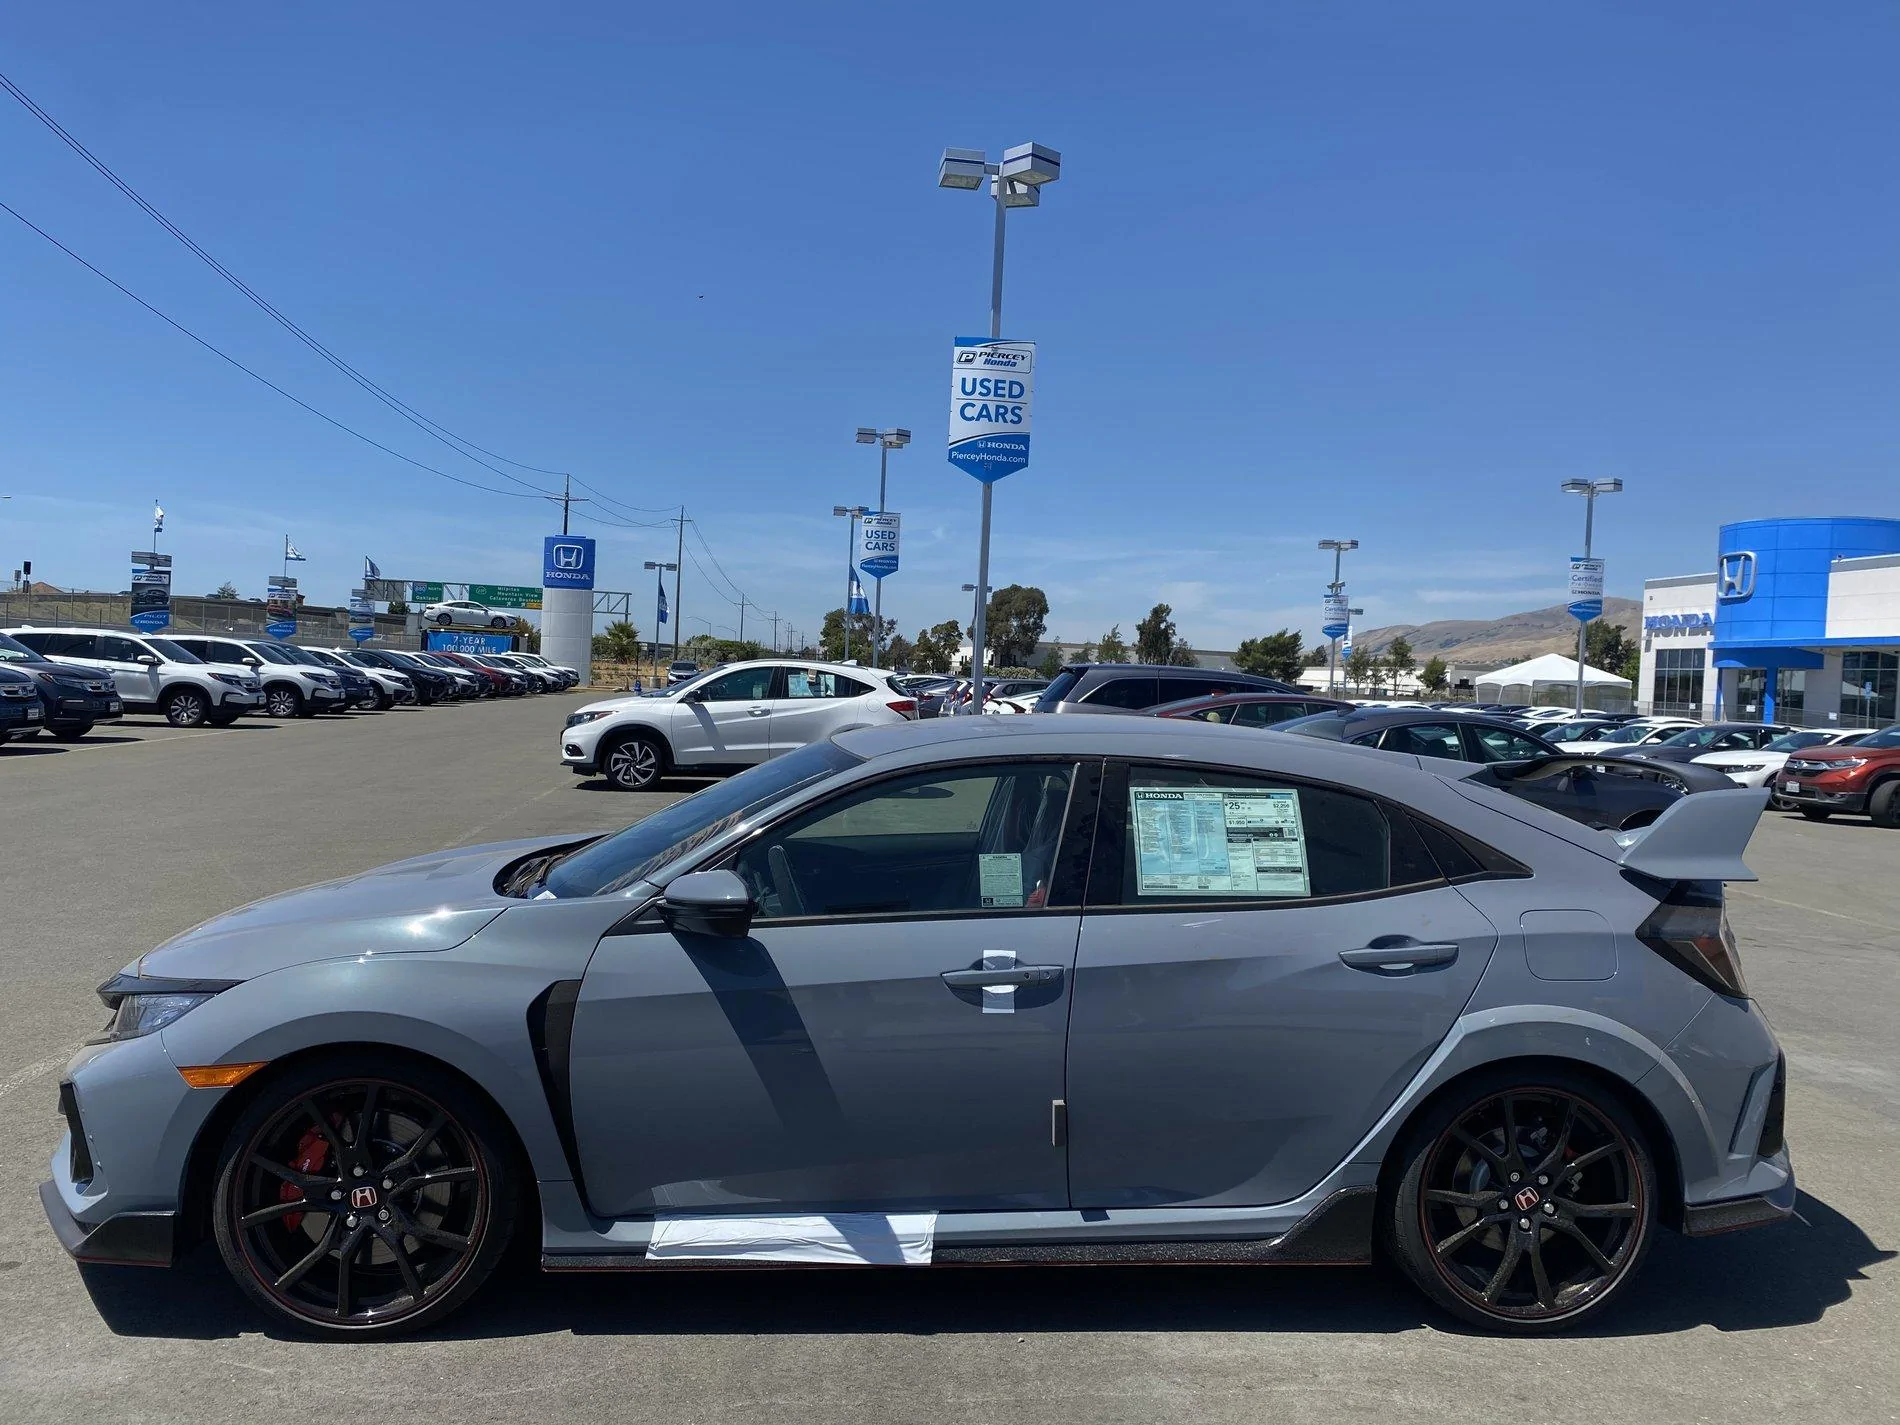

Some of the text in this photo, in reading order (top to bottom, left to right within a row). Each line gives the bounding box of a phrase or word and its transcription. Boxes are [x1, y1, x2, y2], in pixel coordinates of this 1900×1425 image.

[978, 351, 1028, 361] PIERCEY
[983, 358, 1018, 368] Honda
[960, 377, 1025, 399] USED
[959, 402, 1023, 425] CARS
[987, 441, 1026, 451] HONDA
[951, 451, 1026, 464] PierceyHonda.com
[865, 529, 896, 540] USED
[865, 541, 895, 552] CARS
[545, 571, 591, 580] HONDA
[1572, 574, 1603, 583] Certified
[1644, 612, 1715, 630] HONDA
[453, 635, 486, 645] 7-YEAR
[476, 646, 497, 654] MILE
[1229, 801, 1241, 810] 25
